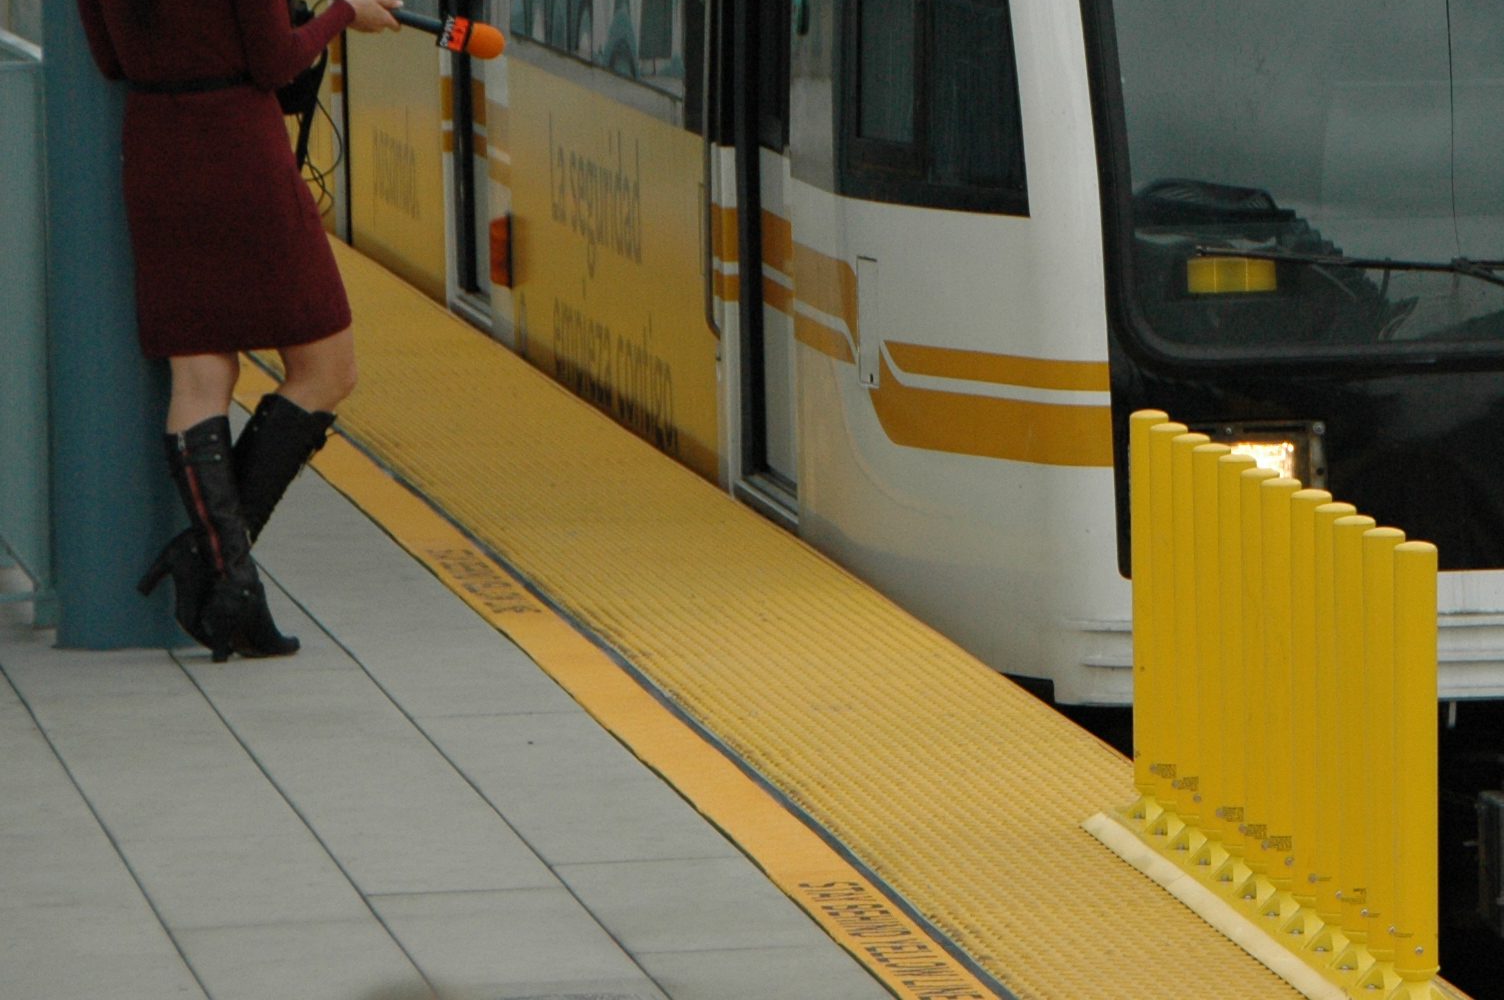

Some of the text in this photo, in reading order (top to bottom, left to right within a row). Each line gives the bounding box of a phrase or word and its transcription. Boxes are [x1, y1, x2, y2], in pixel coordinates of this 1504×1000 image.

[549, 110, 643, 279] La seguridad
[820, 903, 912, 938] BEHIND
[860, 937, 960, 977] YELLOW
